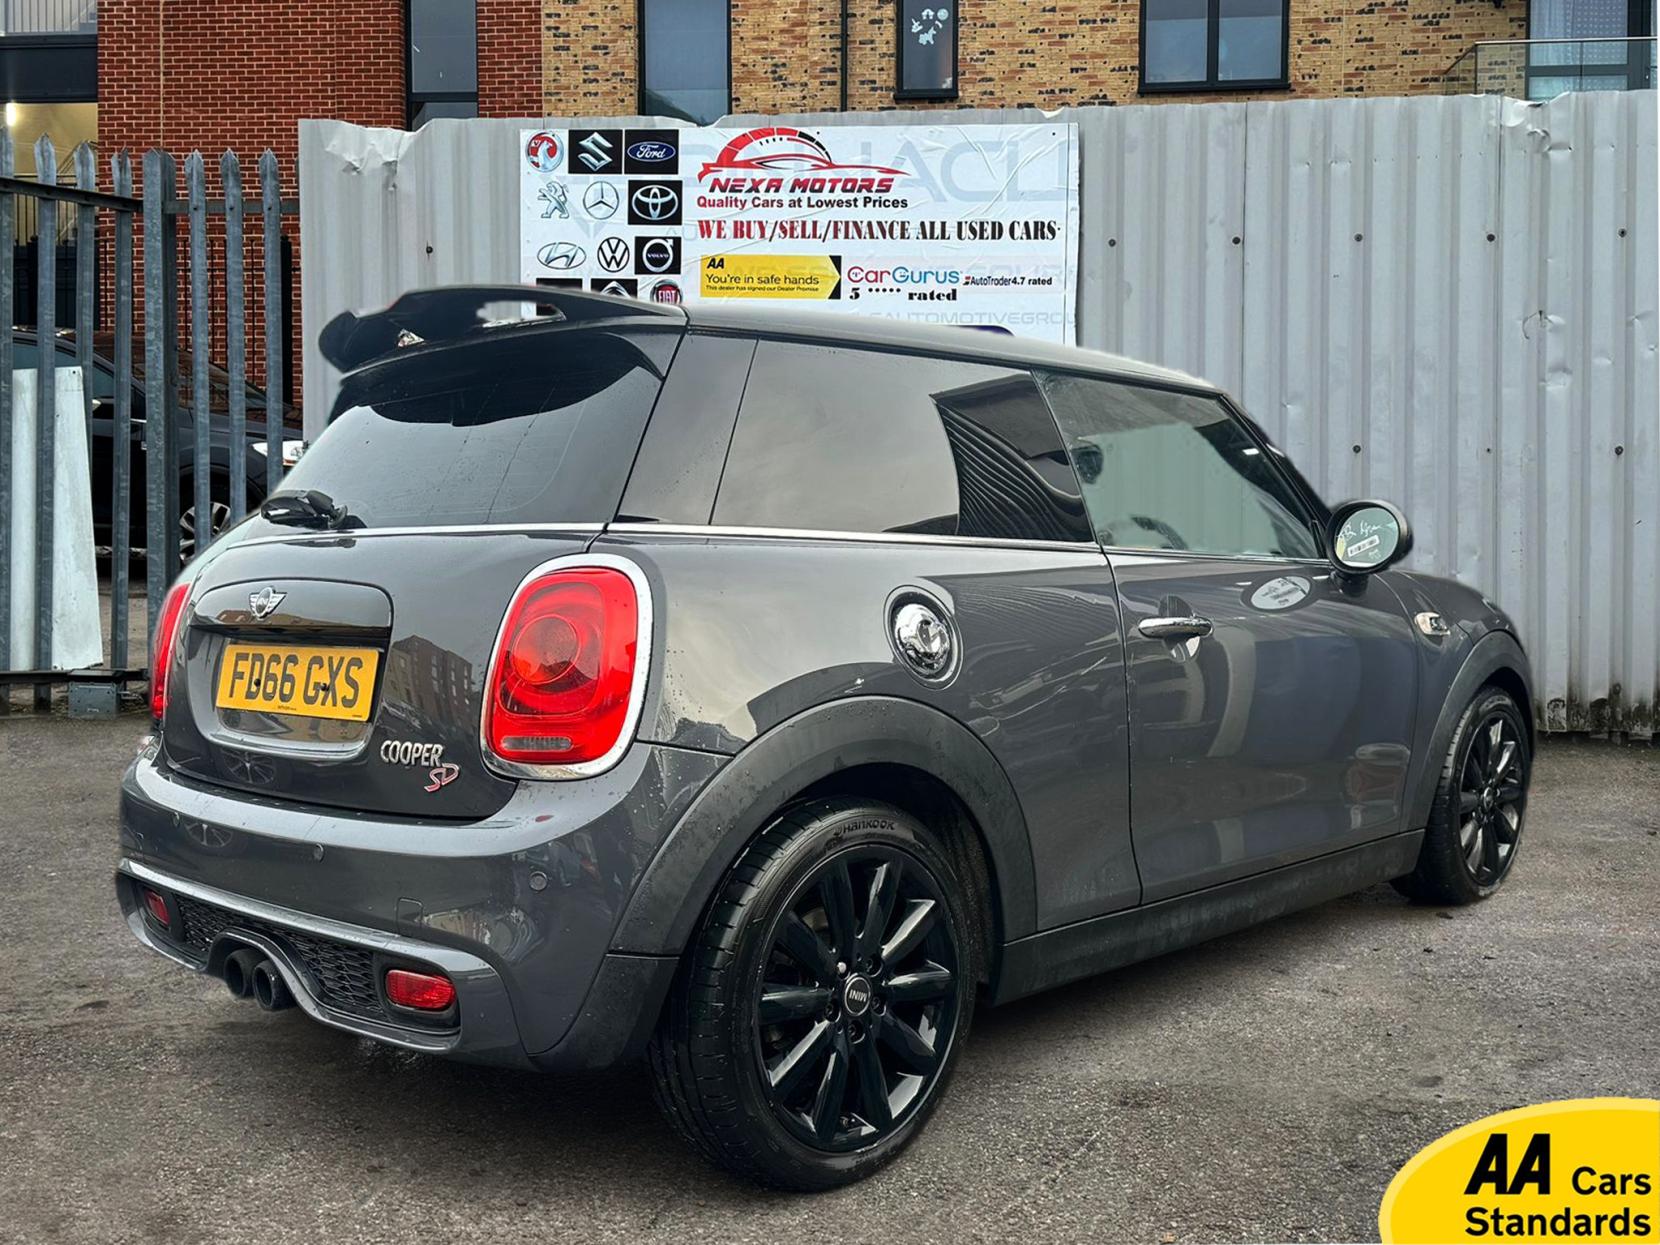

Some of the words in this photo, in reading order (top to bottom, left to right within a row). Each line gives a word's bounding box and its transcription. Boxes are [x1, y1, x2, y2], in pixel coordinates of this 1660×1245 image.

[636, 144, 666, 158] Ford
[708, 178, 784, 193] NEXA
[789, 178, 894, 193] MOTORS
[697, 196, 747, 210] Quality
[751, 196, 784, 208] Cars
[788, 197, 802, 208] at
[807, 196, 858, 208] Lowest
[863, 196, 908, 208] Prices
[697, 220, 727, 239] WE
[916, 220, 951, 240] ALL
[956, 220, 1003, 240] USED
[1009, 220, 1057, 241] CARS
[706, 257, 725, 269] AA
[705, 273, 741, 284] You're
[744, 274, 754, 284] in
[757, 274, 781, 284] safe
[783, 275, 820, 285] hands
[847, 266, 960, 284] CarGurus
[1027, 276, 1053, 286] rated
[658, 290, 677, 304] FIAT
[849, 287, 860, 301] 5
[907, 288, 958, 301] rated
[228, 652, 300, 701] FD66
[302, 655, 363, 708] GXS
[380, 740, 444, 767] COOPER
[849, 989, 868, 1002] MINI
